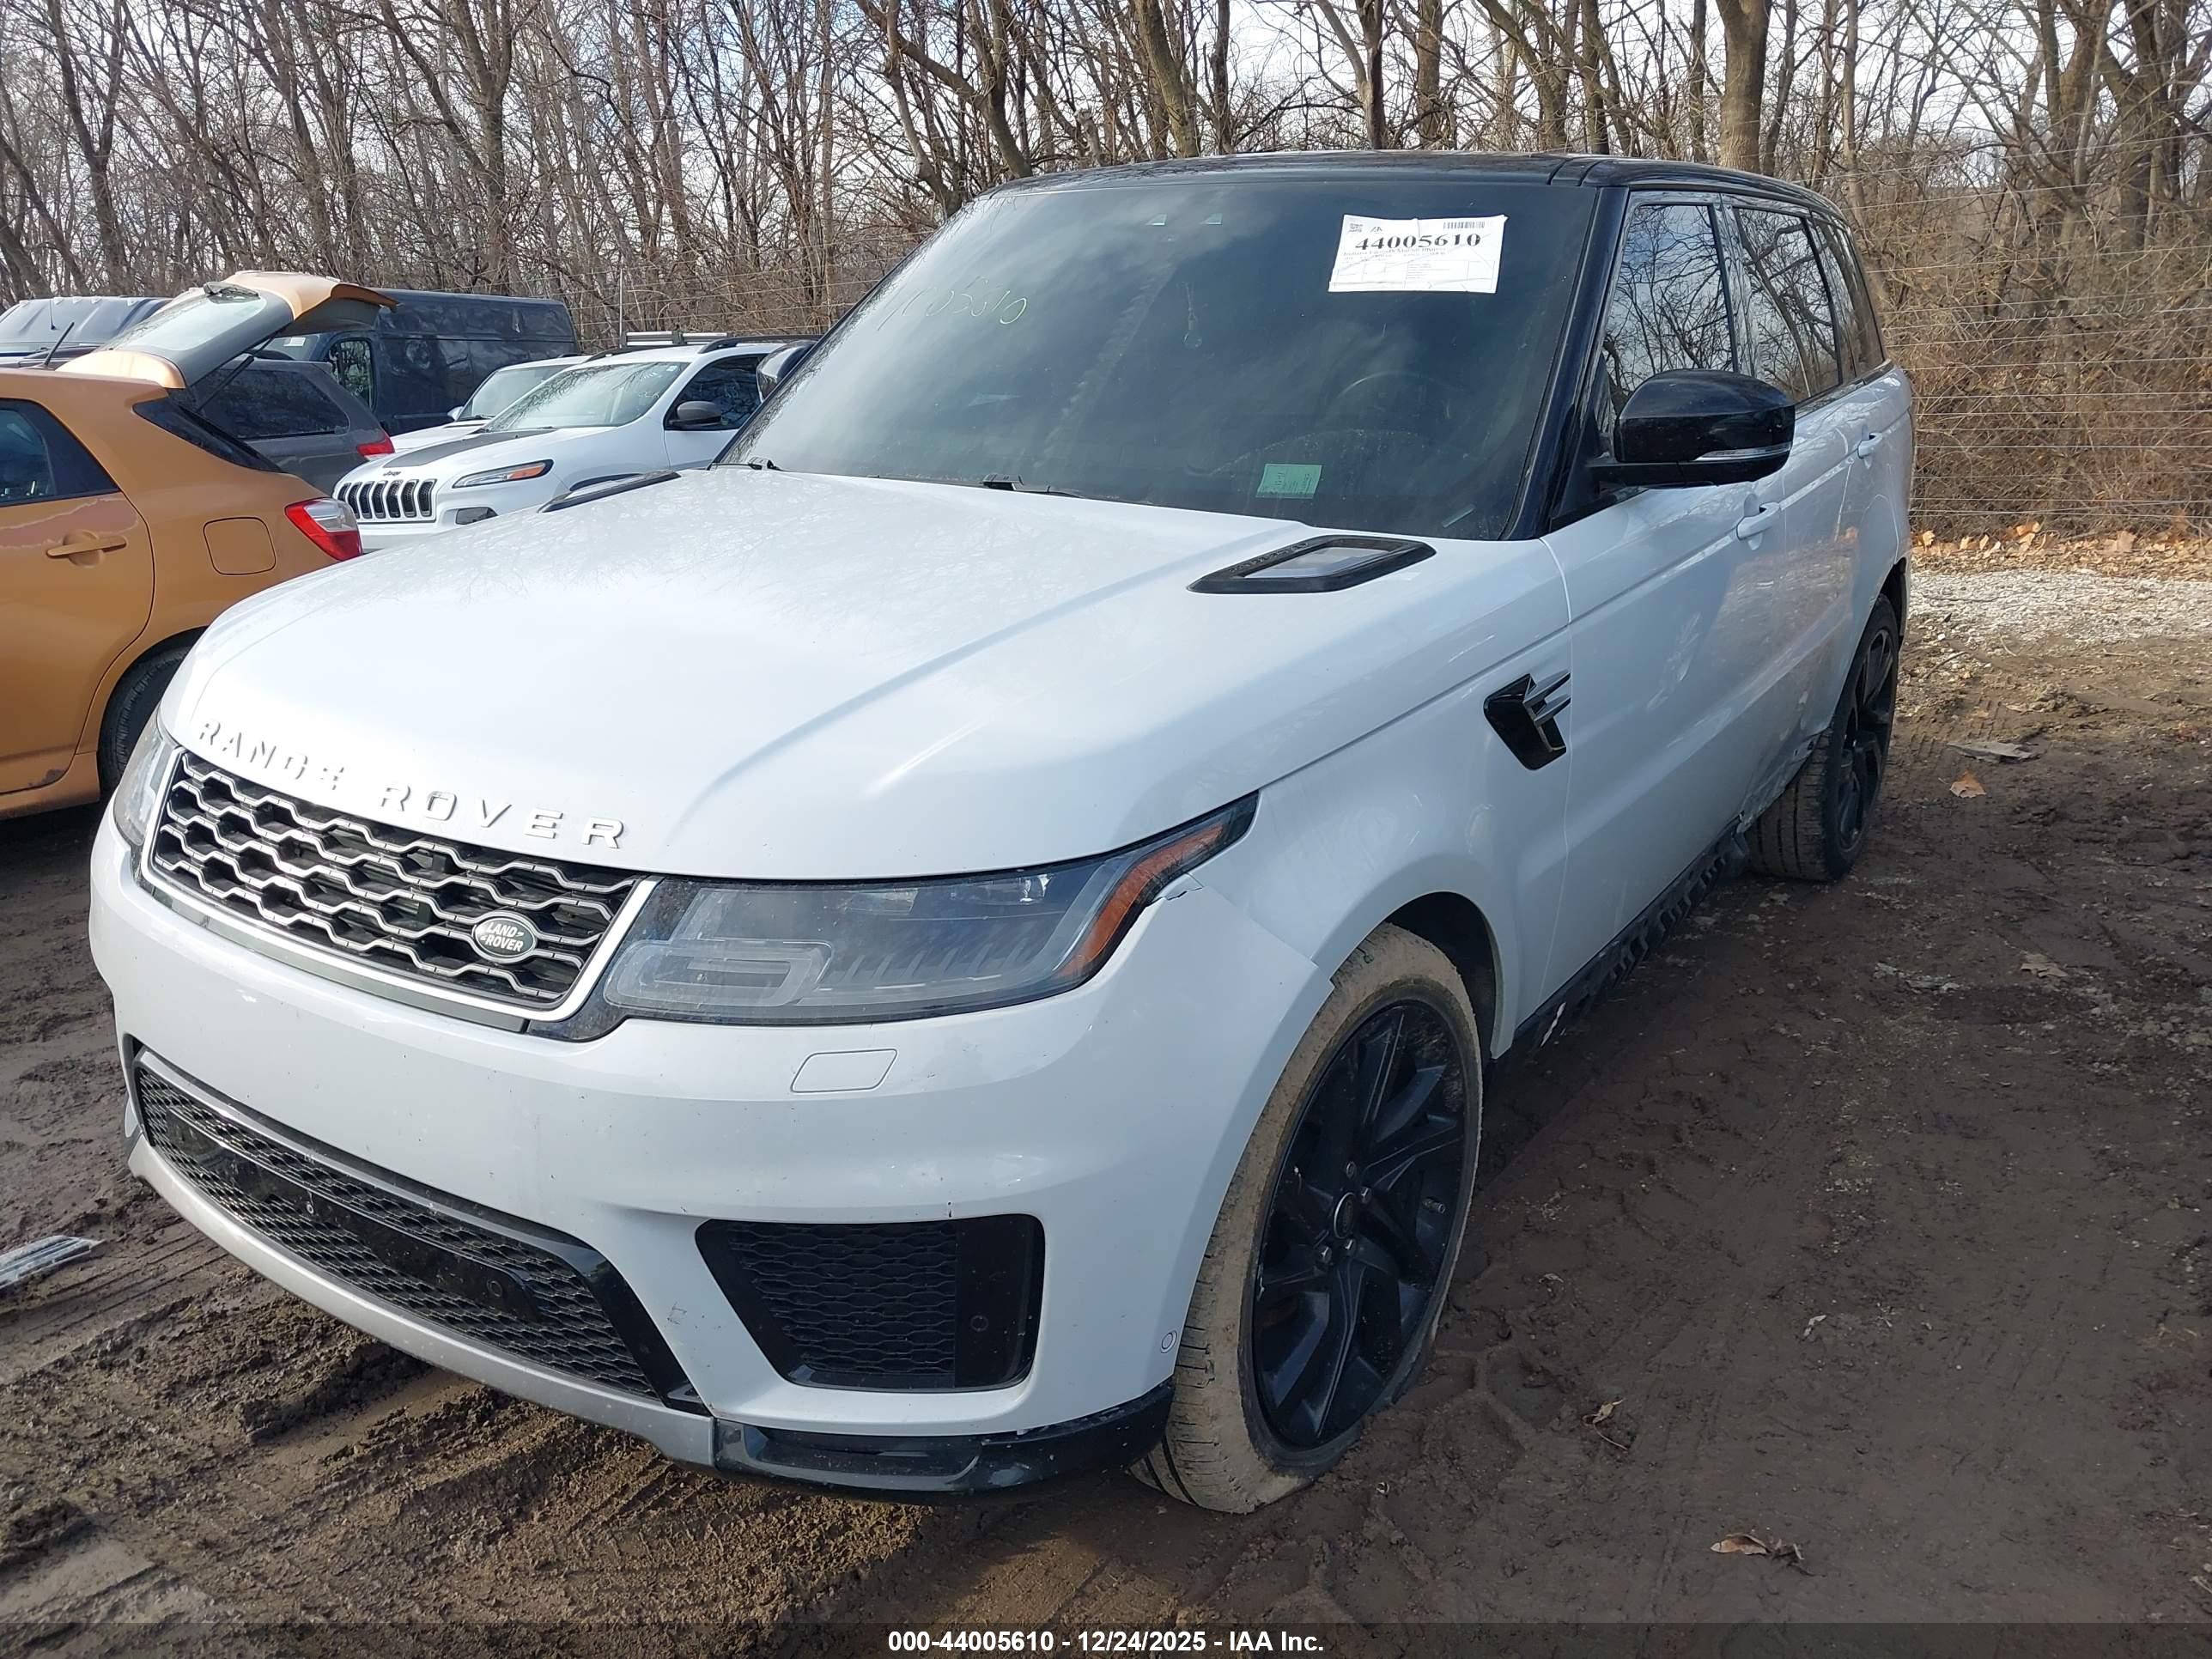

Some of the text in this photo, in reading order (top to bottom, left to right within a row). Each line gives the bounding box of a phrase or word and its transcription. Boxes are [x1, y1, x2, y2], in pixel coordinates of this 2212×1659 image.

[1355, 233, 1481, 251] 44005610
[380, 783, 625, 850] ROVER
[486, 921, 518, 938] LAND
[484, 933, 524, 952] ROVER
